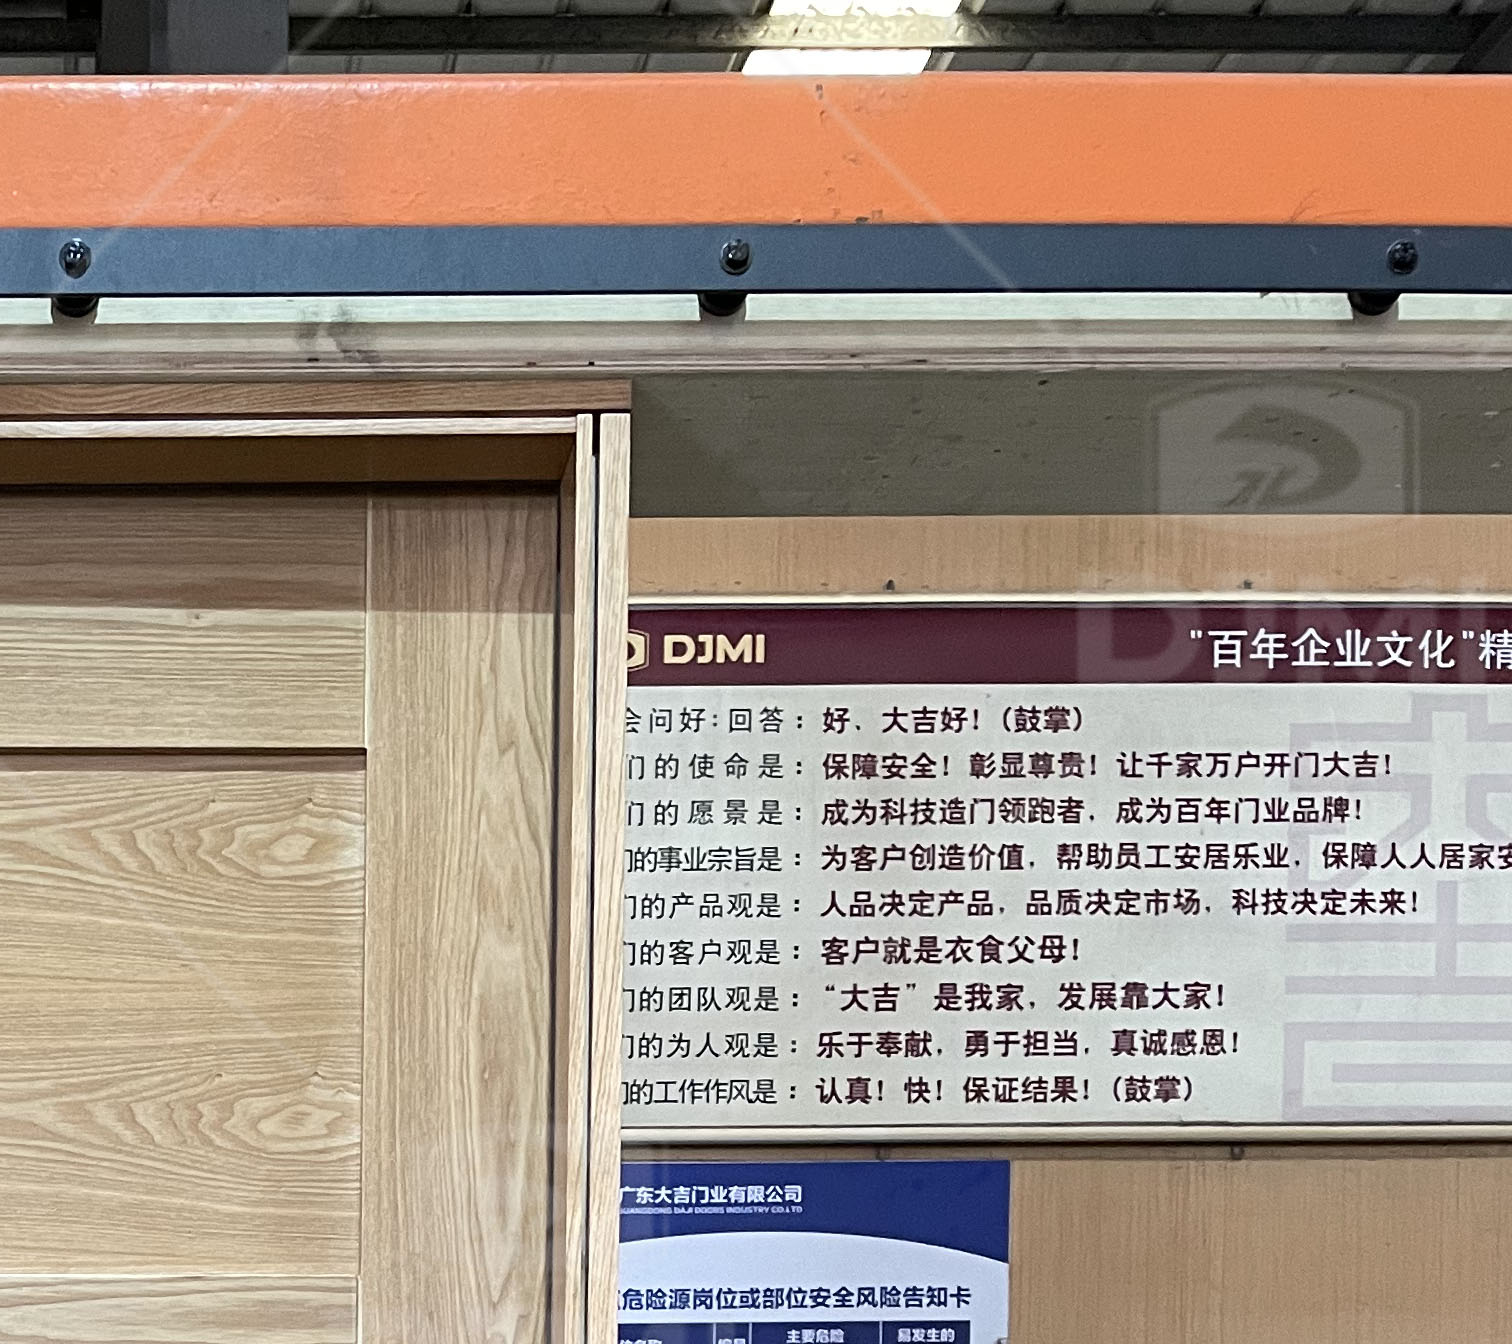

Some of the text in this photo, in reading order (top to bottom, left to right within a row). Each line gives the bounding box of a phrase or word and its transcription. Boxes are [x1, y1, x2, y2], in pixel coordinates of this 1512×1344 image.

[664, 634, 765, 663] DJMI
[619, 1186, 802, 1204] 广东大吉门业有限公司
[617, 1286, 972, 1310] 危险源岗位或部位安全风险告知卡
